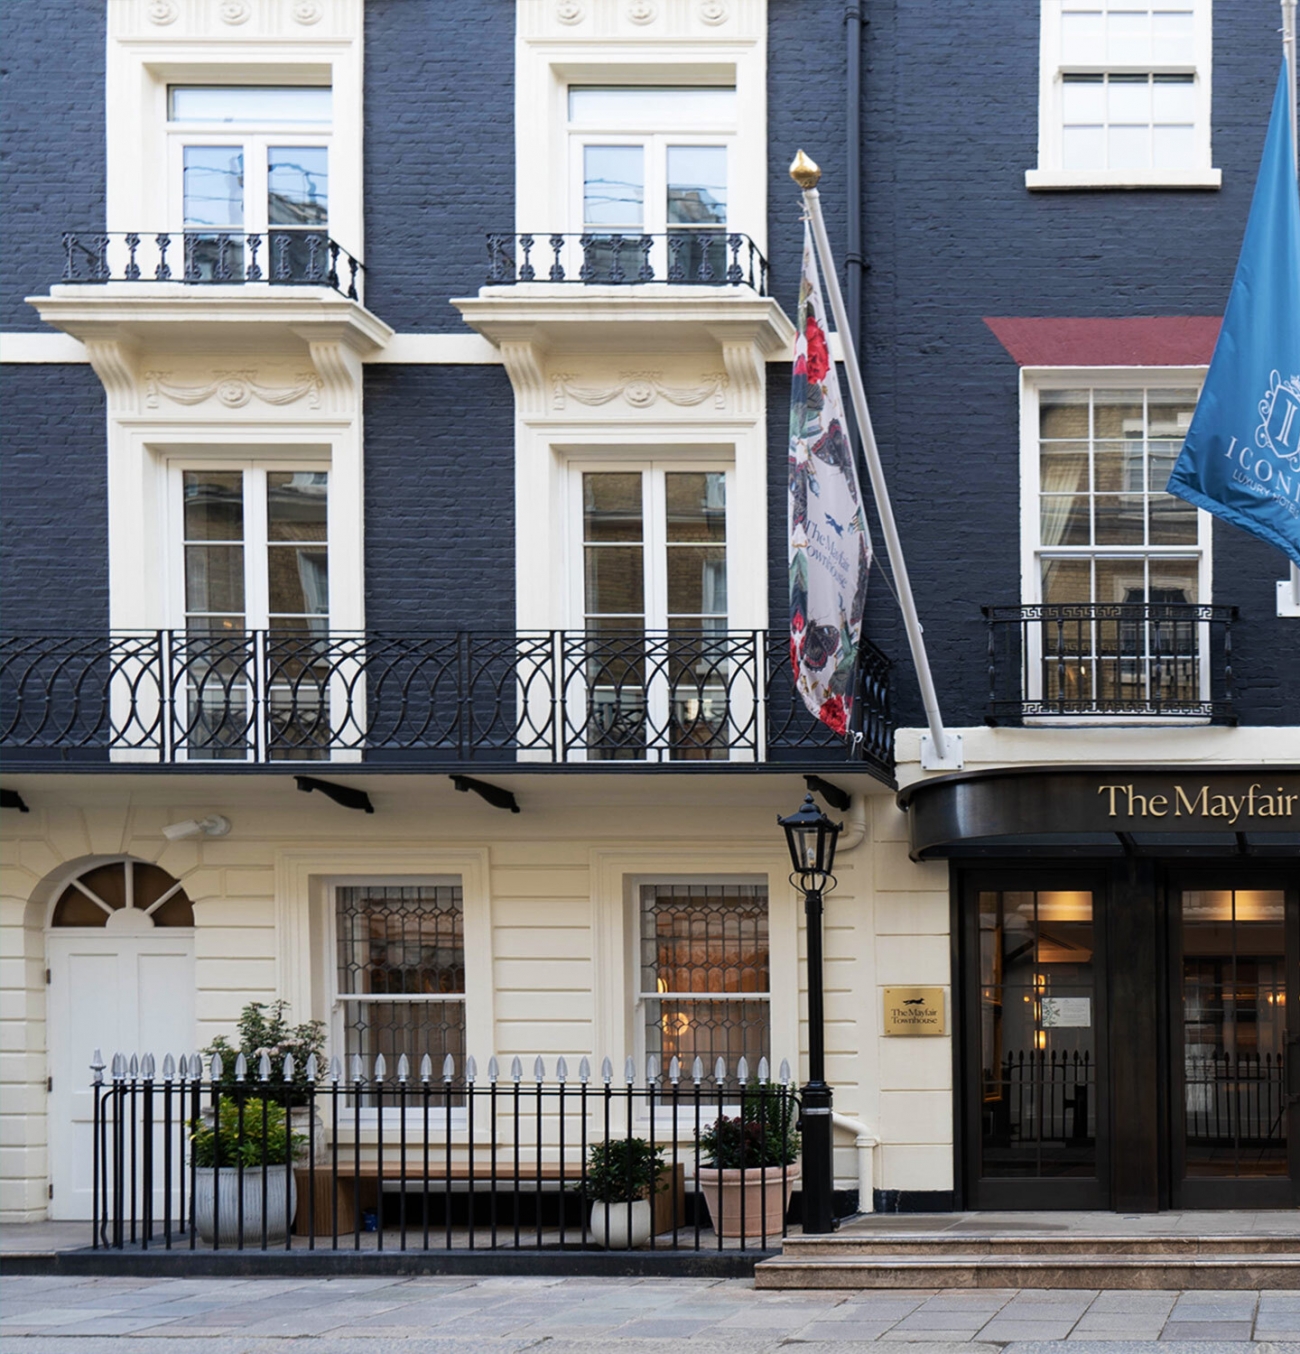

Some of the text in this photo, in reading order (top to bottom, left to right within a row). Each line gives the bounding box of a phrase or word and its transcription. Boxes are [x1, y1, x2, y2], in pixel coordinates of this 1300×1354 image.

[1275, 398, 1299, 448] I
[1232, 468, 1300, 520] LUXURY HOTELS
[806, 538, 848, 589] ownhouse
[1097, 783, 1169, 817] The
[1174, 783, 1300, 825] Mayfair
[891, 1008, 938, 1018] The Mayfair
[891, 1016, 938, 1025] Townhouse
